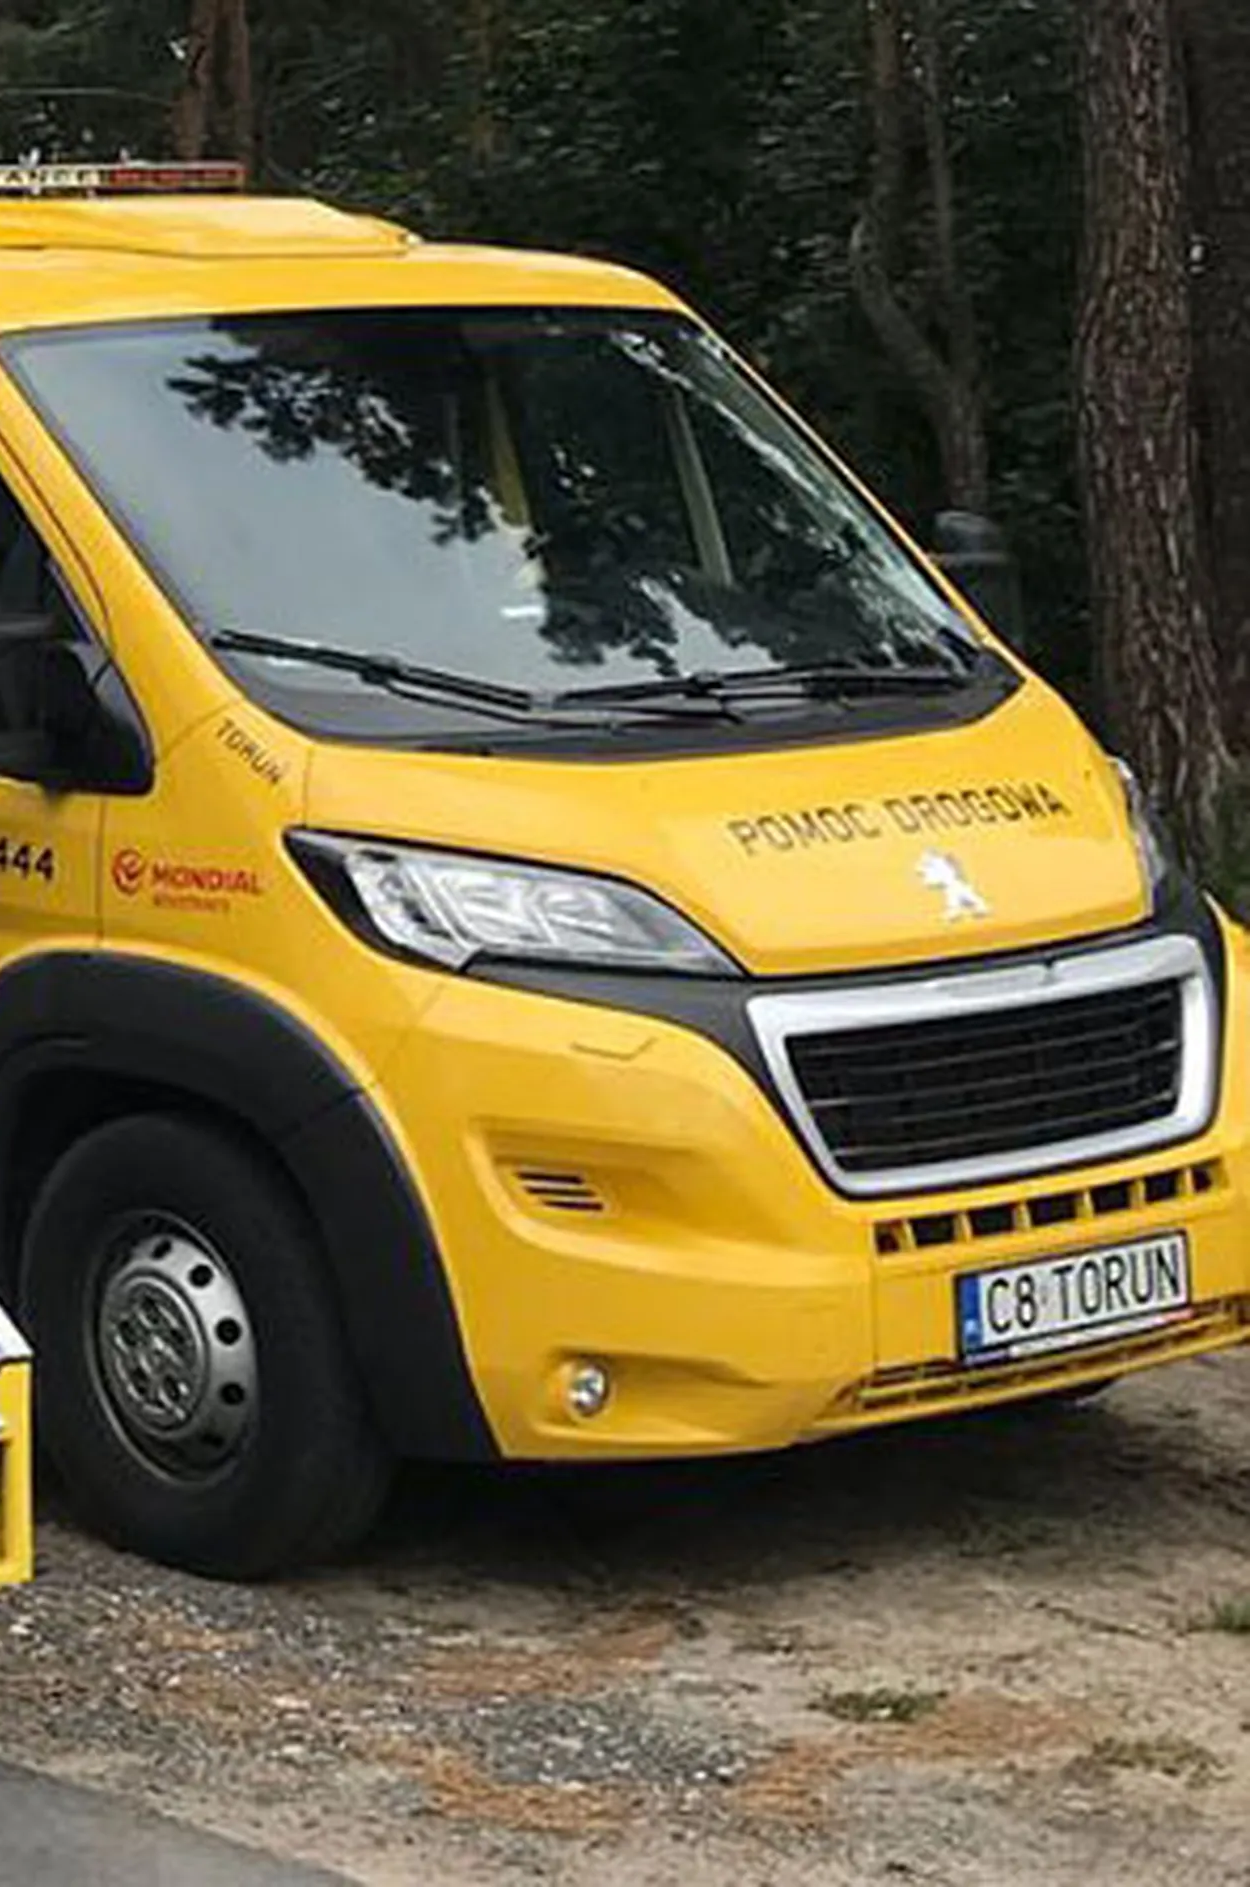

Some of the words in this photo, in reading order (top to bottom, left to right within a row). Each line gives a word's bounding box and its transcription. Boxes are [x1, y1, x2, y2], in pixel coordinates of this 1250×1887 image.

[216, 717, 290, 786] TORUN
[727, 802, 881, 855] POMOC
[884, 782, 1072, 833] DROGOWA
[152, 862, 264, 895] MONDIAL
[987, 1273, 1037, 1334] C8
[1052, 1243, 1181, 1321] TORUN
